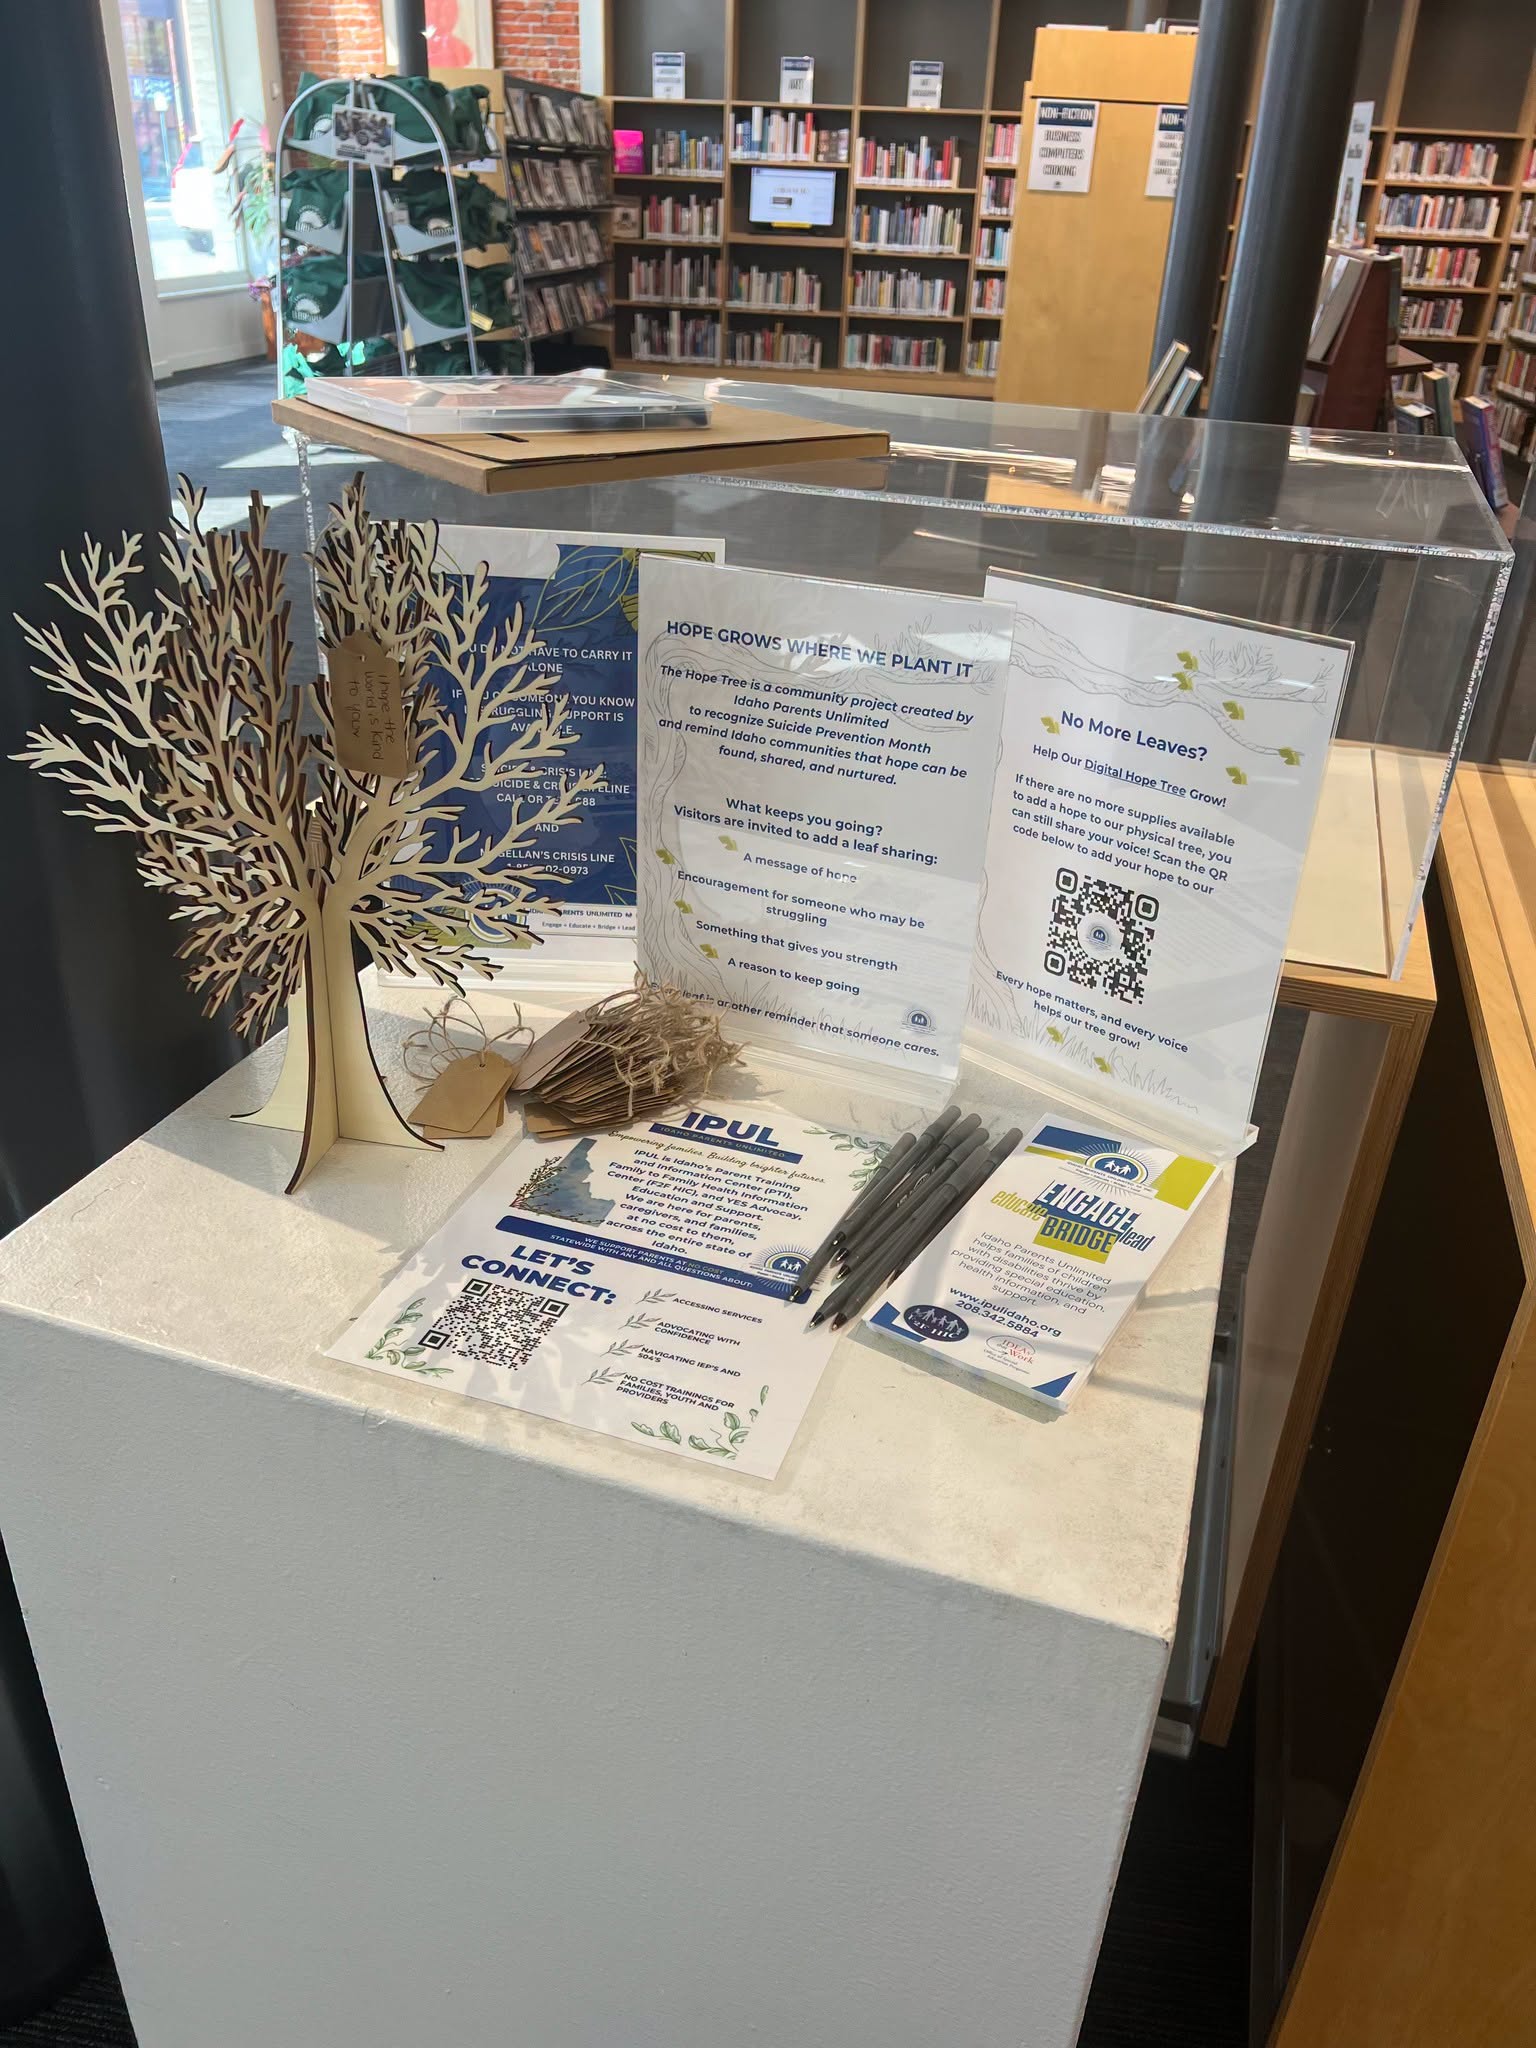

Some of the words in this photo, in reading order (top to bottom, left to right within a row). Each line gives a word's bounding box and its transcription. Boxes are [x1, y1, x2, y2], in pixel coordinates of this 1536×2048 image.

[563, 648, 578, 658] TO
[581, 649, 619, 660] CARRY
[622, 651, 632, 661] IT
[667, 620, 713, 640] HOPE
[717, 628, 782, 651] GROWS
[786, 638, 852, 661] WHERE
[856, 648, 887, 666] WE
[891, 653, 952, 675] PLANT
[956, 662, 973, 678] IT
[348, 680, 360, 696] to
[364, 671, 377, 708] world
[572, 695, 596, 705] YOU
[599, 697, 635, 707] KNOW
[660, 664, 682, 678] The
[685, 668, 717, 684] Hope
[721, 674, 747, 688] Tree
[750, 678, 761, 690] is
[763, 683, 772, 693] a
[774, 685, 849, 706] community
[849, 697, 898, 712] project
[900, 705, 954, 720] created
[955, 710, 974, 725] by
[345, 703, 360, 738] you
[367, 713, 379, 725] is
[378, 681, 390, 712] hope
[384, 717, 396, 744] the
[614, 712, 624, 722] IS
[689, 705, 702, 716] to
[704, 709, 764, 727] recognize
[766, 718, 812, 735] Suicide
[815, 726, 885, 747] Prevention
[888, 737, 931, 754] Month
[733, 694, 770, 710] Idaho
[772, 701, 822, 719] Parents
[825, 709, 889, 729] Unlimited
[1061, 710, 1084, 729] No
[1088, 717, 1131, 742] More
[1136, 730, 1207, 761] Leaves?
[718, 744, 757, 763] found,
[759, 752, 806, 771] shared,
[808, 763, 835, 774] and
[836, 767, 896, 785] nurtured.
[1032, 744, 1059, 761] Help
[1061, 752, 1082, 766] Our
[1083, 758, 1124, 781] Digital
[1123, 769, 1158, 791] Hope
[1157, 779, 1186, 797] Tree
[1189, 788, 1227, 808] Grow!
[535, 824, 559, 833] AND
[726, 797, 761, 814] What
[765, 804, 804, 822] keeps
[806, 814, 831, 827] you
[835, 820, 883, 837] going?
[1015, 773, 1024, 784] If
[1025, 776, 1055, 793] there
[1056, 787, 1075, 799] are
[1077, 793, 1092, 804] no
[1094, 798, 1125, 814] more
[1127, 808, 1177, 830] supplies
[1179, 824, 1235, 847] available
[673, 804, 721, 823] Visitors
[724, 817, 744, 828] are
[747, 818, 792, 838] invited
[795, 829, 810, 841] to
[812, 833, 838, 846] add
[841, 839, 849, 848] a
[853, 838, 879, 853] leaf
[881, 845, 938, 866] sharing:
[1011, 807, 1031, 820] can
[1033, 814, 1053, 827] still
[1055, 820, 1086, 837] share
[1087, 831, 1114, 846] your
[1116, 839, 1151, 857] voice!
[1152, 849, 1181, 867] Scan
[1184, 860, 1206, 874] the
[1208, 867, 1228, 881] QR
[553, 852, 588, 861] CRISIS
[590, 853, 615, 862] LINE
[996, 970, 1024, 989] Every
[1025, 981, 1052, 999] hope
[1054, 995, 1098, 1019] matters,
[1100, 1013, 1122, 1027] and
[1124, 1022, 1156, 1041] every
[1157, 1035, 1188, 1053] voice
[1033, 999, 1062, 1018] helps
[1063, 1014, 1082, 1026] our
[1084, 1020, 1106, 1036] tree
[1108, 1032, 1140, 1048] grow!
[660, 1127, 690, 1136] IDAHO
[691, 1133, 733, 1146] PARENTS
[735, 1143, 785, 1158] UNLIMITED
[680, 1112, 780, 1148] IPUL
[633, 1149, 659, 1160] IPUL
[673, 1158, 712, 1171] Idaho's
[714, 1167, 752, 1180] Parent
[755, 1176, 801, 1192] Training
[619, 1203, 681, 1222] caregivers,
[683, 1218, 708, 1227] and
[708, 1223, 757, 1240] families,
[625, 1193, 644, 1202] We
[645, 1199, 665, 1207] are
[666, 1203, 693, 1214] here
[695, 1209, 713, 1218] for
[713, 1215, 761, 1231] parents,
[991, 1190, 1048, 1222] educate
[1037, 1183, 1136, 1233] ENGAGE
[1040, 1217, 1118, 1254] BRIDGE
[1118, 1227, 1156, 1252] lead
[510, 1244, 595, 1275] LET'S
[972, 1237, 1002, 1253] helps
[1004, 1249, 1045, 1269] families
[1047, 1267, 1061, 1275] of
[1060, 1272, 1107, 1293] children
[980, 1231, 1012, 1247] Idaho
[1013, 1243, 1055, 1264] Parents
[1057, 1260, 1112, 1285] Unlimited
[461, 1254, 617, 1305] CONNECT:
[991, 1284, 1037, 1306] support.
[672, 1297, 720, 1313] ACCESSING
[721, 1309, 762, 1324] SERVICES
[949, 1287, 1062, 1337] www.ipulidaho.org
[955, 1299, 1039, 1338] 208.342.5884
[623, 1372, 638, 1382] NO
[639, 1378, 664, 1389] COST
[665, 1384, 714, 1403] TRAININGS
[714, 1398, 735, 1408] FOR
